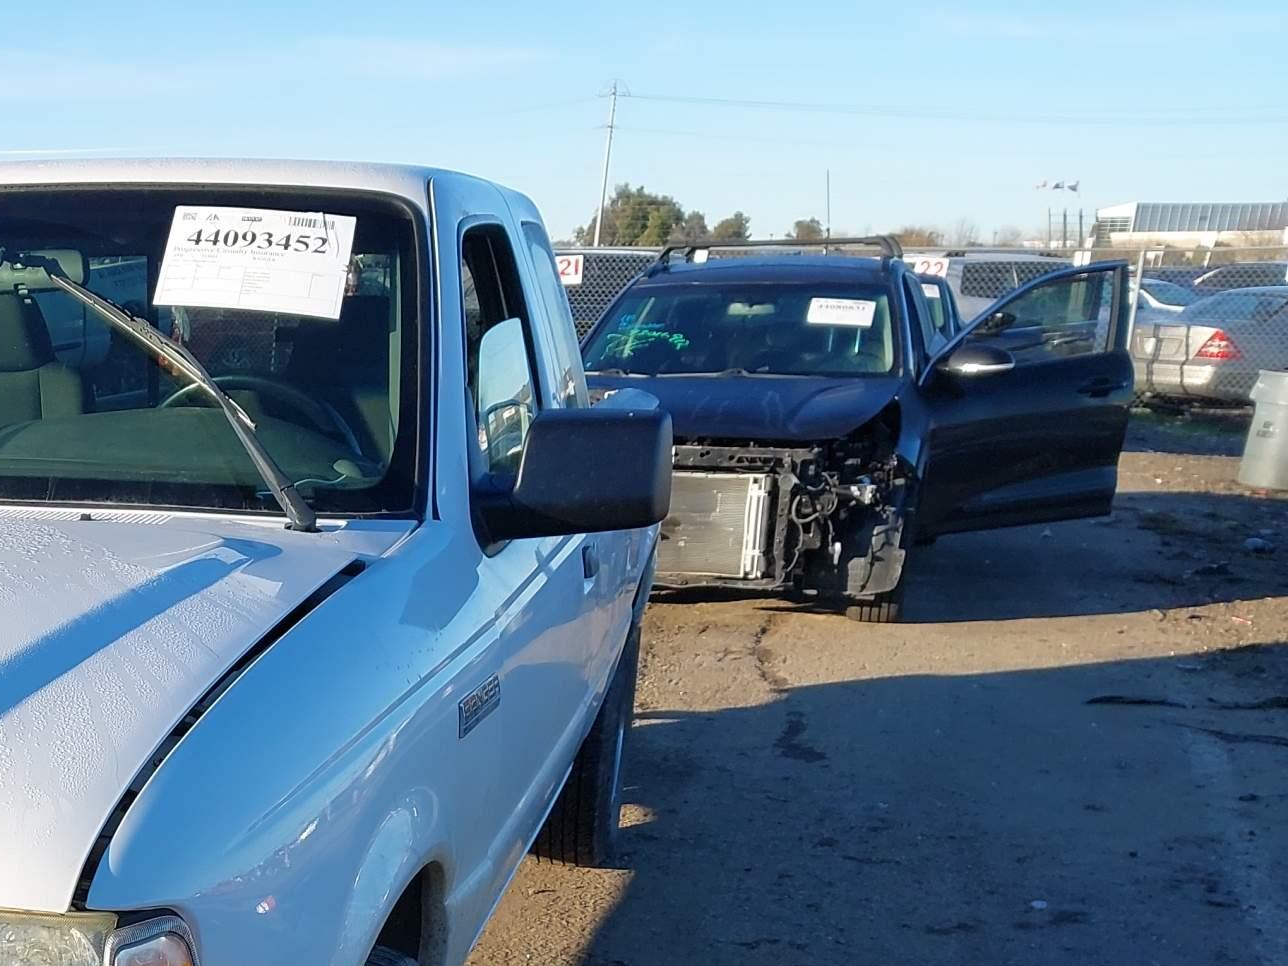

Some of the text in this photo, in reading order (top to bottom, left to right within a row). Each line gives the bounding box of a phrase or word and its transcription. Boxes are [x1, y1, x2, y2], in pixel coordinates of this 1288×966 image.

[187, 228, 329, 254] 44093452
[558, 257, 579, 276] 21
[920, 260, 944, 275] 22
